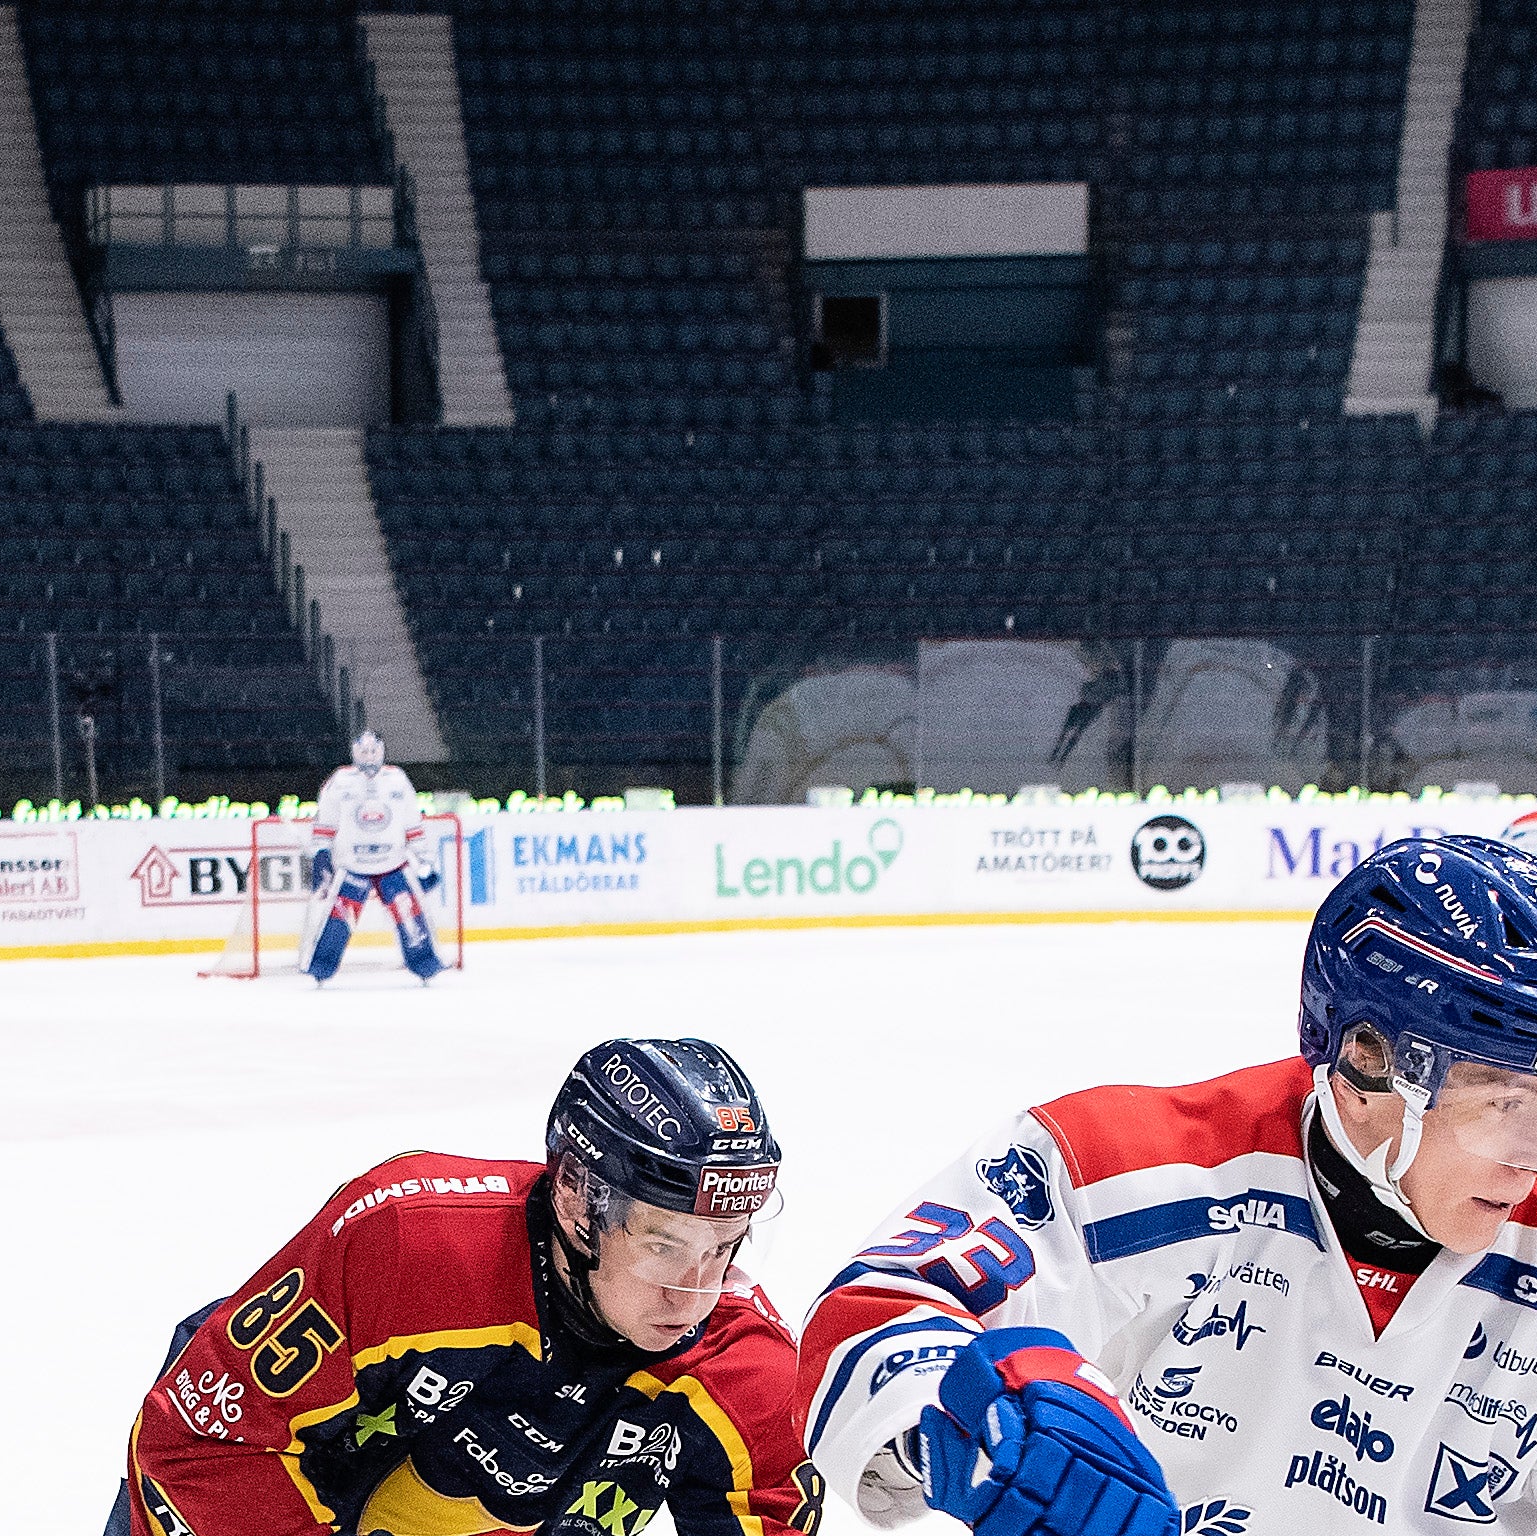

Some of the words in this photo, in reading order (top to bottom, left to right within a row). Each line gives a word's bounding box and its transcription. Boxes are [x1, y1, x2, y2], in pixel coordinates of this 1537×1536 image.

[513, 832, 648, 868] EKMANS
[714, 838, 880, 899] Lendo
[600, 1052, 681, 1142] ROTOTEC
[715, 1105, 756, 1133] 85
[567, 1123, 604, 1162] CCM
[711, 1137, 763, 1151] CCM
[702, 1170, 776, 1194] Prioritet
[710, 1190, 763, 1213] Finans
[852, 1200, 1038, 1318] 33
[1355, 1267, 1400, 1294] SHL
[225, 1266, 348, 1399] 85
[1313, 1350, 1416, 1403] BAUER
[506, 1411, 566, 1454] CCM
[1169, 1399, 1239, 1435] KOGYO
[1309, 1392, 1396, 1464] elajo
[1283, 1449, 1389, 1526] plåtson
